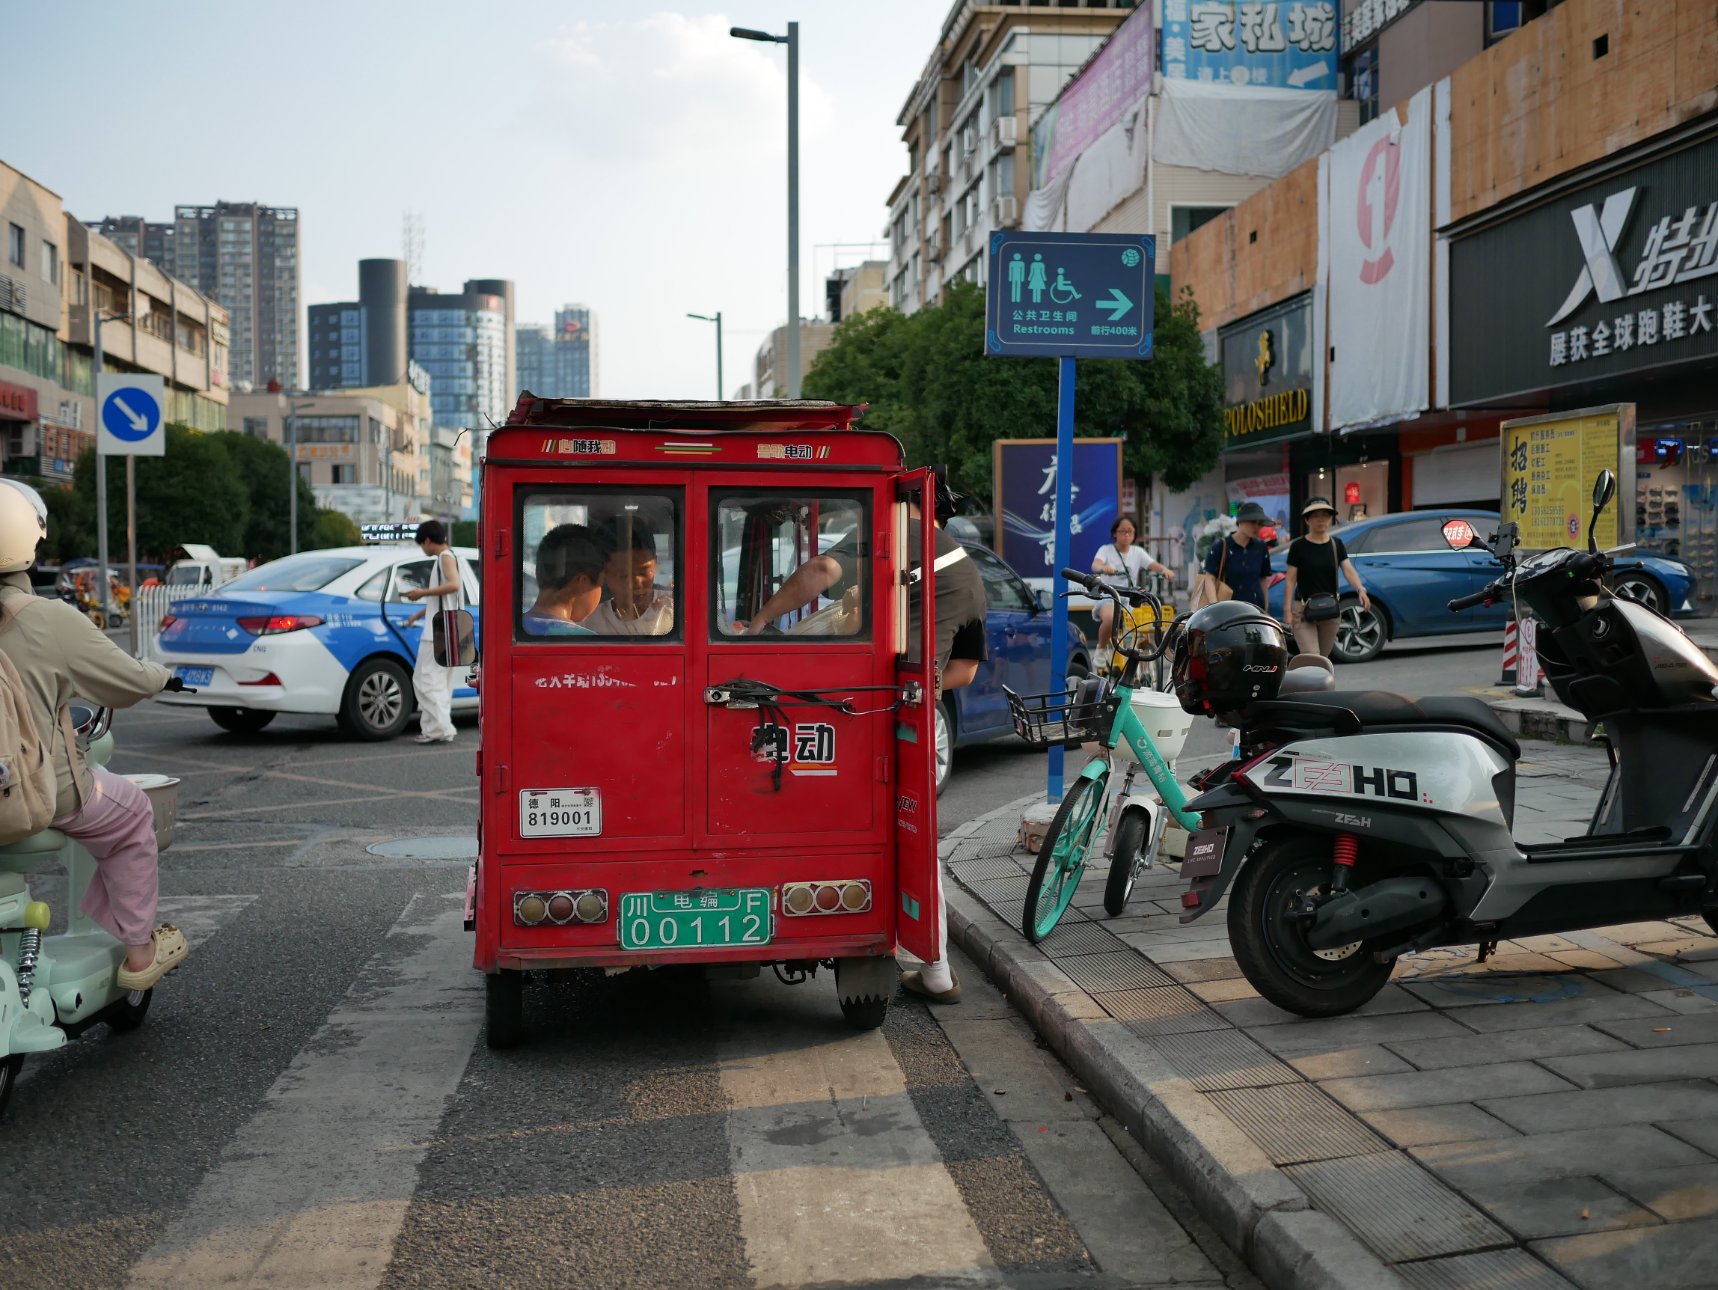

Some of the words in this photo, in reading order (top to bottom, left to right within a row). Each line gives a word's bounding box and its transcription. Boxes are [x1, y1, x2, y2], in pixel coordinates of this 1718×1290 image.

[1191, 1, 1336, 52] 家私城
[1012, 310, 1078, 322] 公共卫生间
[1013, 324, 1075, 335] Restrooms
[1091, 326, 1137, 336] 前行400米
[1224, 388, 1308, 438] POLOSHIELD
[1510, 435, 1527, 520] 招聘
[751, 722, 836, 764] 电动
[528, 798, 560, 809] 德阳
[528, 811, 591, 826] 819001
[627, 897, 647, 917] 川
[747, 893, 761, 913] F
[631, 914, 761, 945] 00112
